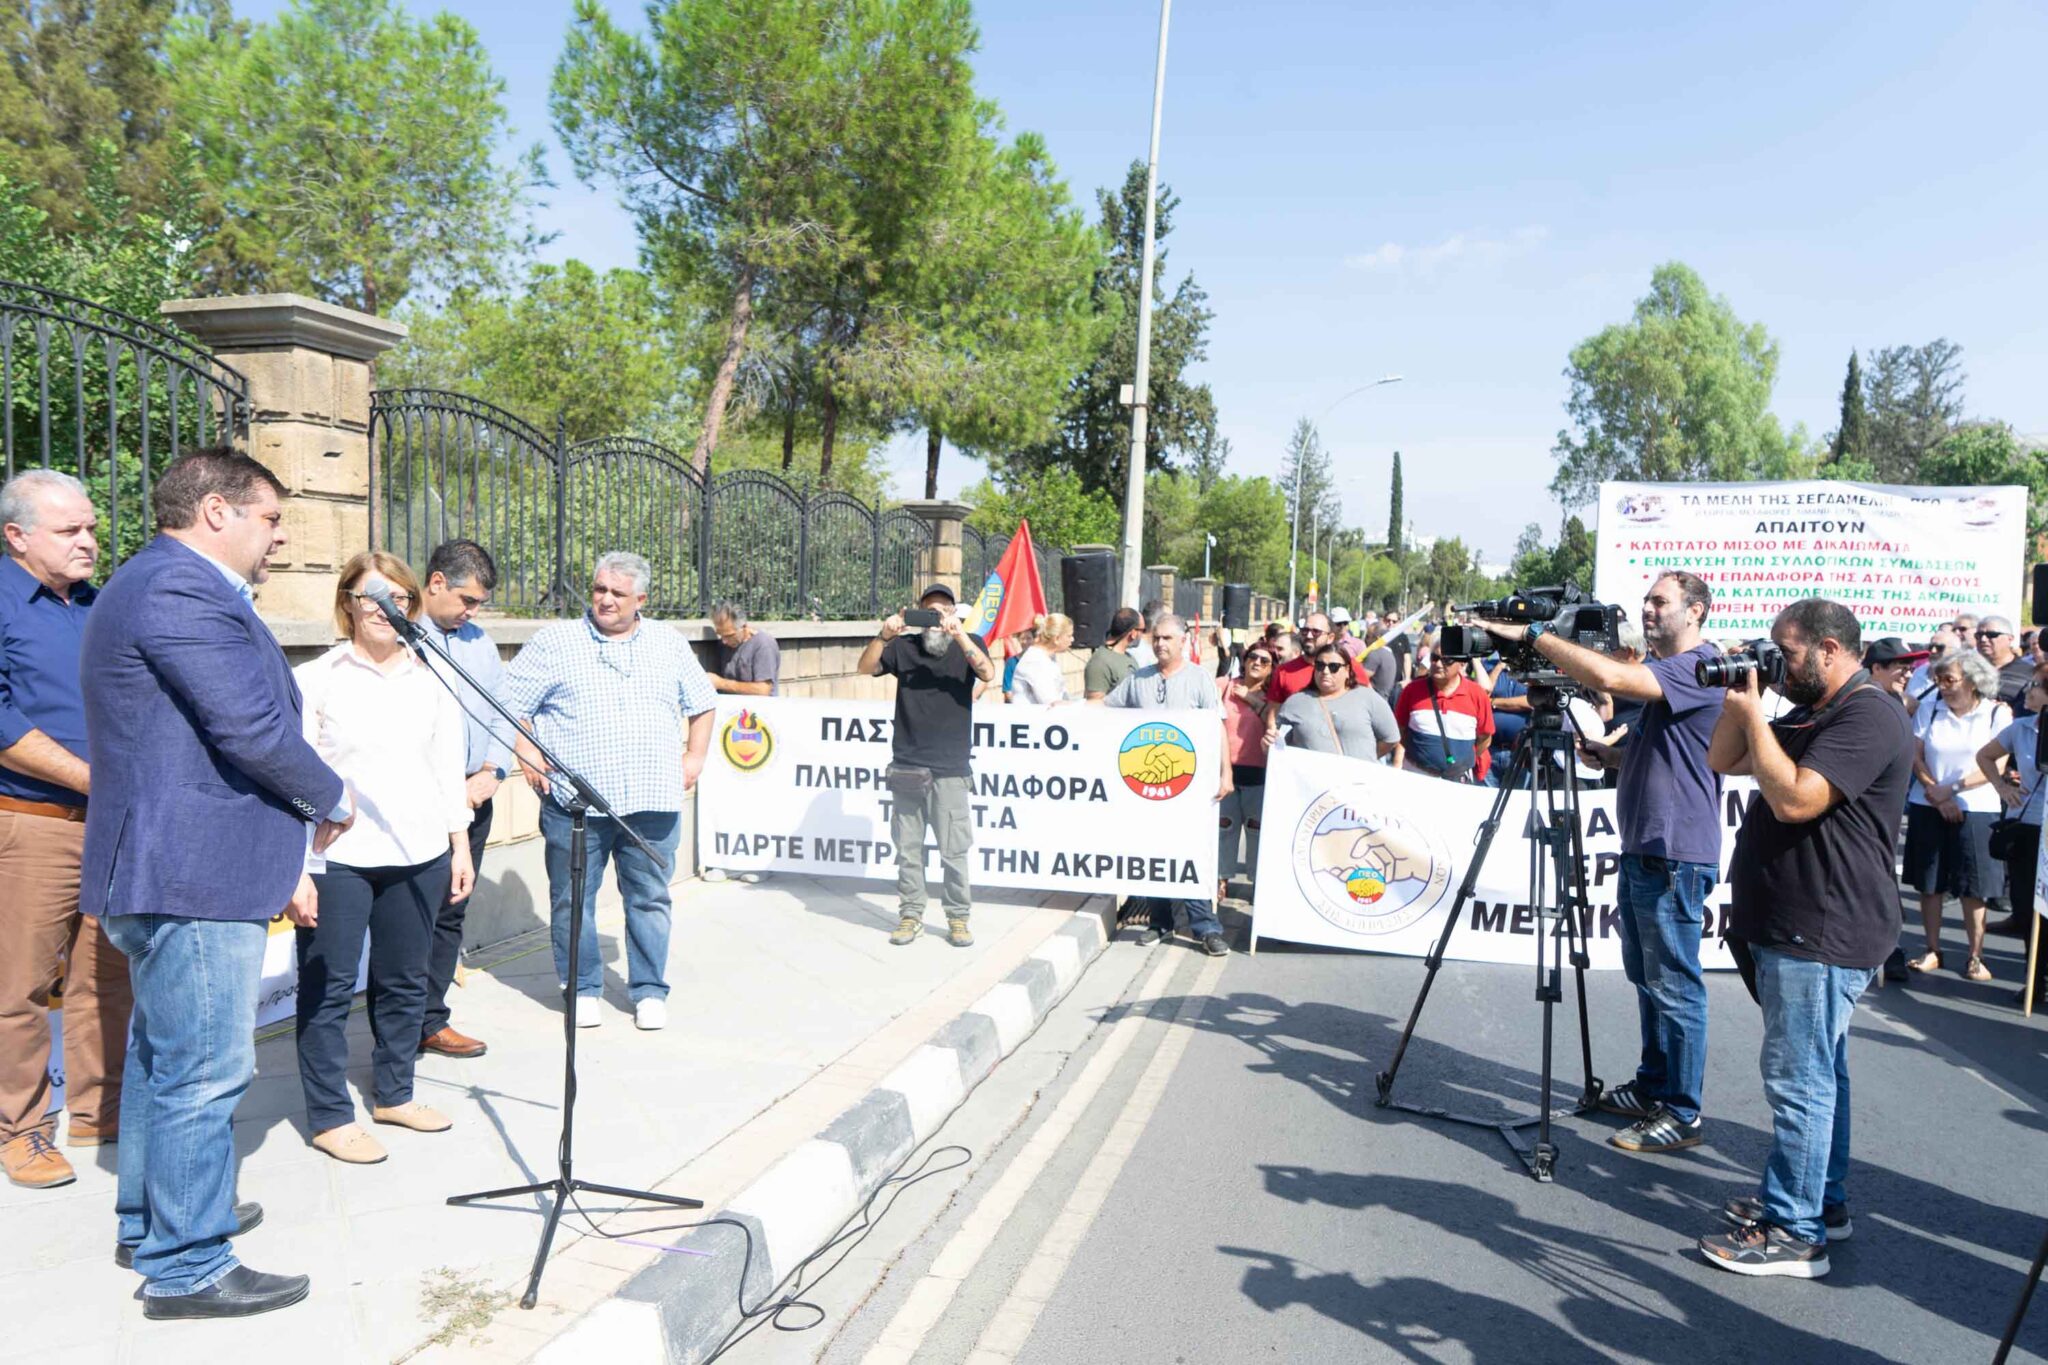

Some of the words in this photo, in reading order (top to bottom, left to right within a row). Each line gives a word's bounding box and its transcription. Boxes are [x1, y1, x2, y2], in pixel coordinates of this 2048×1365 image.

[1681, 494, 1700, 505] ΤΑ
[1707, 494, 1752, 505] ΜΕΛΗ
[1759, 494, 1791, 505] ΤΗΣ
[1755, 520, 1866, 534] ΑΠΑΙΤΟΥΝ
[1630, 540, 1718, 551] ΚΑΤΩΤΑΤΟ
[1783, 540, 1807, 550] ΜΕ
[1644, 556, 1726, 567] ΕΝΙΣΧΥΣΗ
[1732, 556, 1765, 567] ΤΩΝ
[1771, 556, 1874, 568] ΣΥΛΛΟΓΙΚΩΝ
[1719, 571, 1824, 583] ΕΠΑΝΑΦΟΡΑ
[1829, 572, 1857, 583] ΤΗΣ
[1862, 573, 1893, 584] ΑΤΑ
[1882, 589, 1911, 601] ΤΗΣ
[984, 583, 1002, 623] ΠΕΟ
[821, 716, 895, 743] ΠΑΣ
[972, 721, 1080, 751] Π.Ε.Ο.
[1139, 727, 1179, 742] ΠΕΟ
[1142, 785, 1172, 798] 1941
[714, 831, 804, 861] ΠΑΡΤΕ
[813, 837, 899, 865] ΜΕΤΡ
[978, 847, 1040, 875] ΤΗΝ
[1051, 851, 1200, 884] ΑΚΡΙΒΕΙΑ
[1471, 900, 1535, 936] ΜΕ
